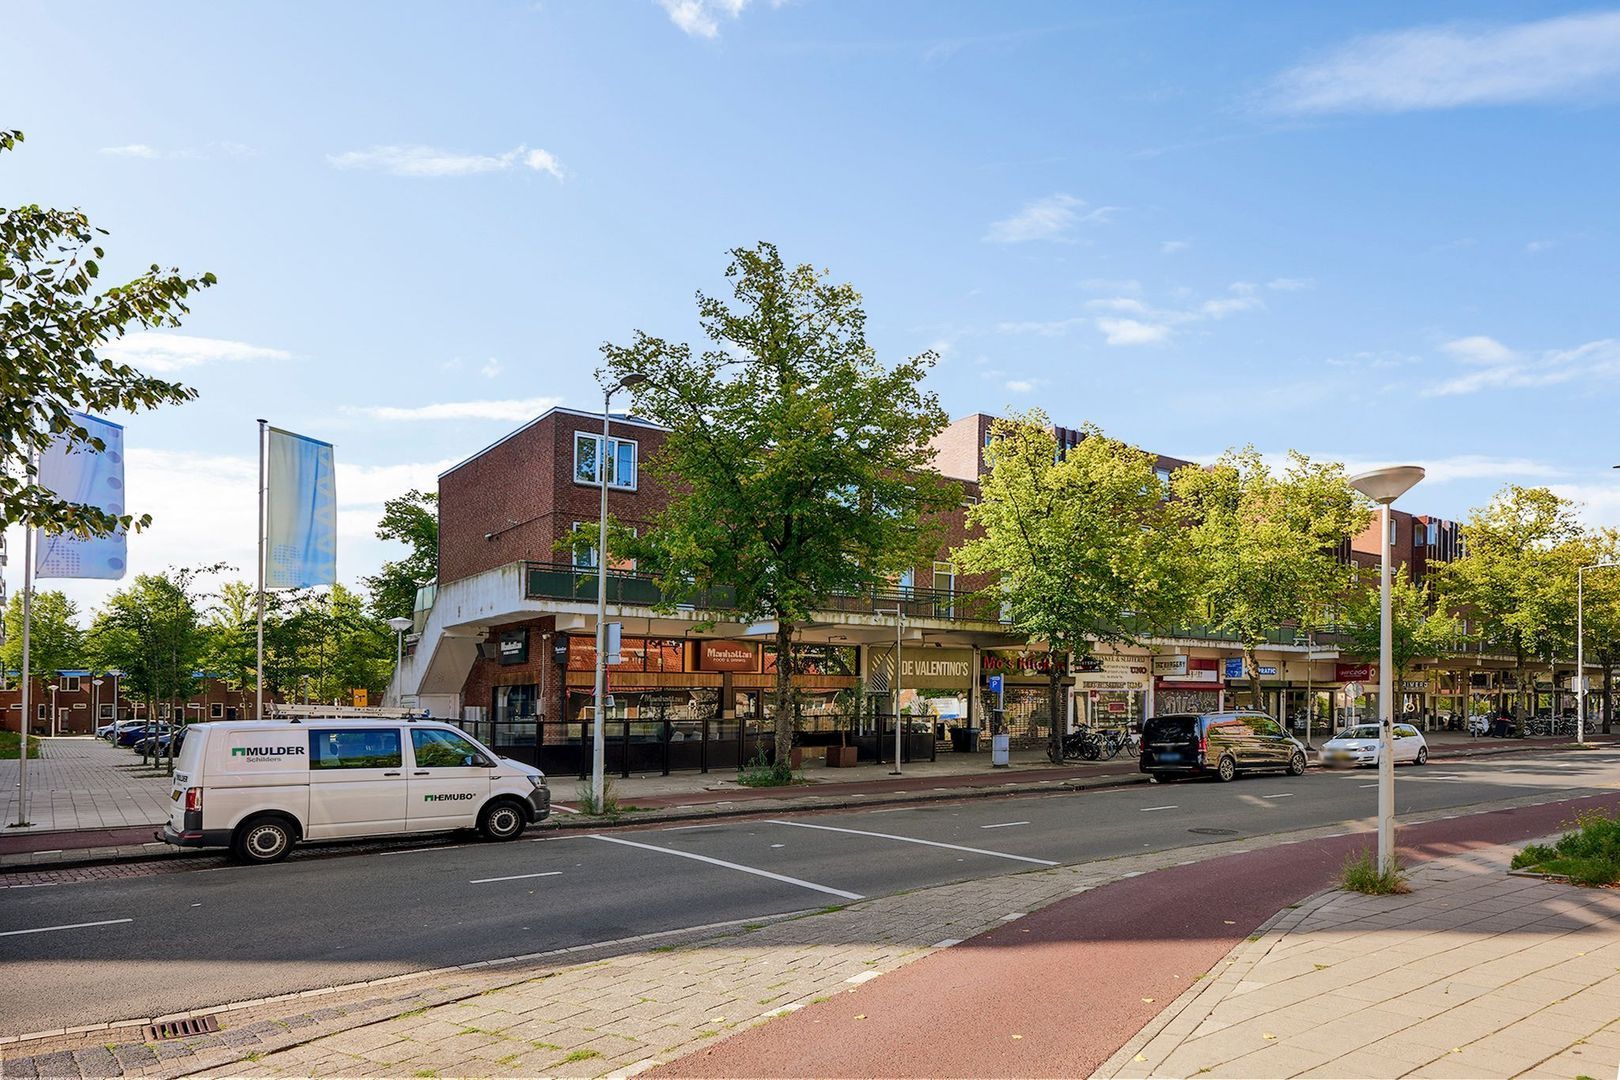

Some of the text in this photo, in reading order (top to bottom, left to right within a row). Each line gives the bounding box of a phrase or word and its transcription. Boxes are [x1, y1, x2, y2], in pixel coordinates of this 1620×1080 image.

[707, 648, 752, 658] Manhattan
[902, 661, 969, 676] DE VALENTINO'S
[246, 746, 305, 756] MULDER
